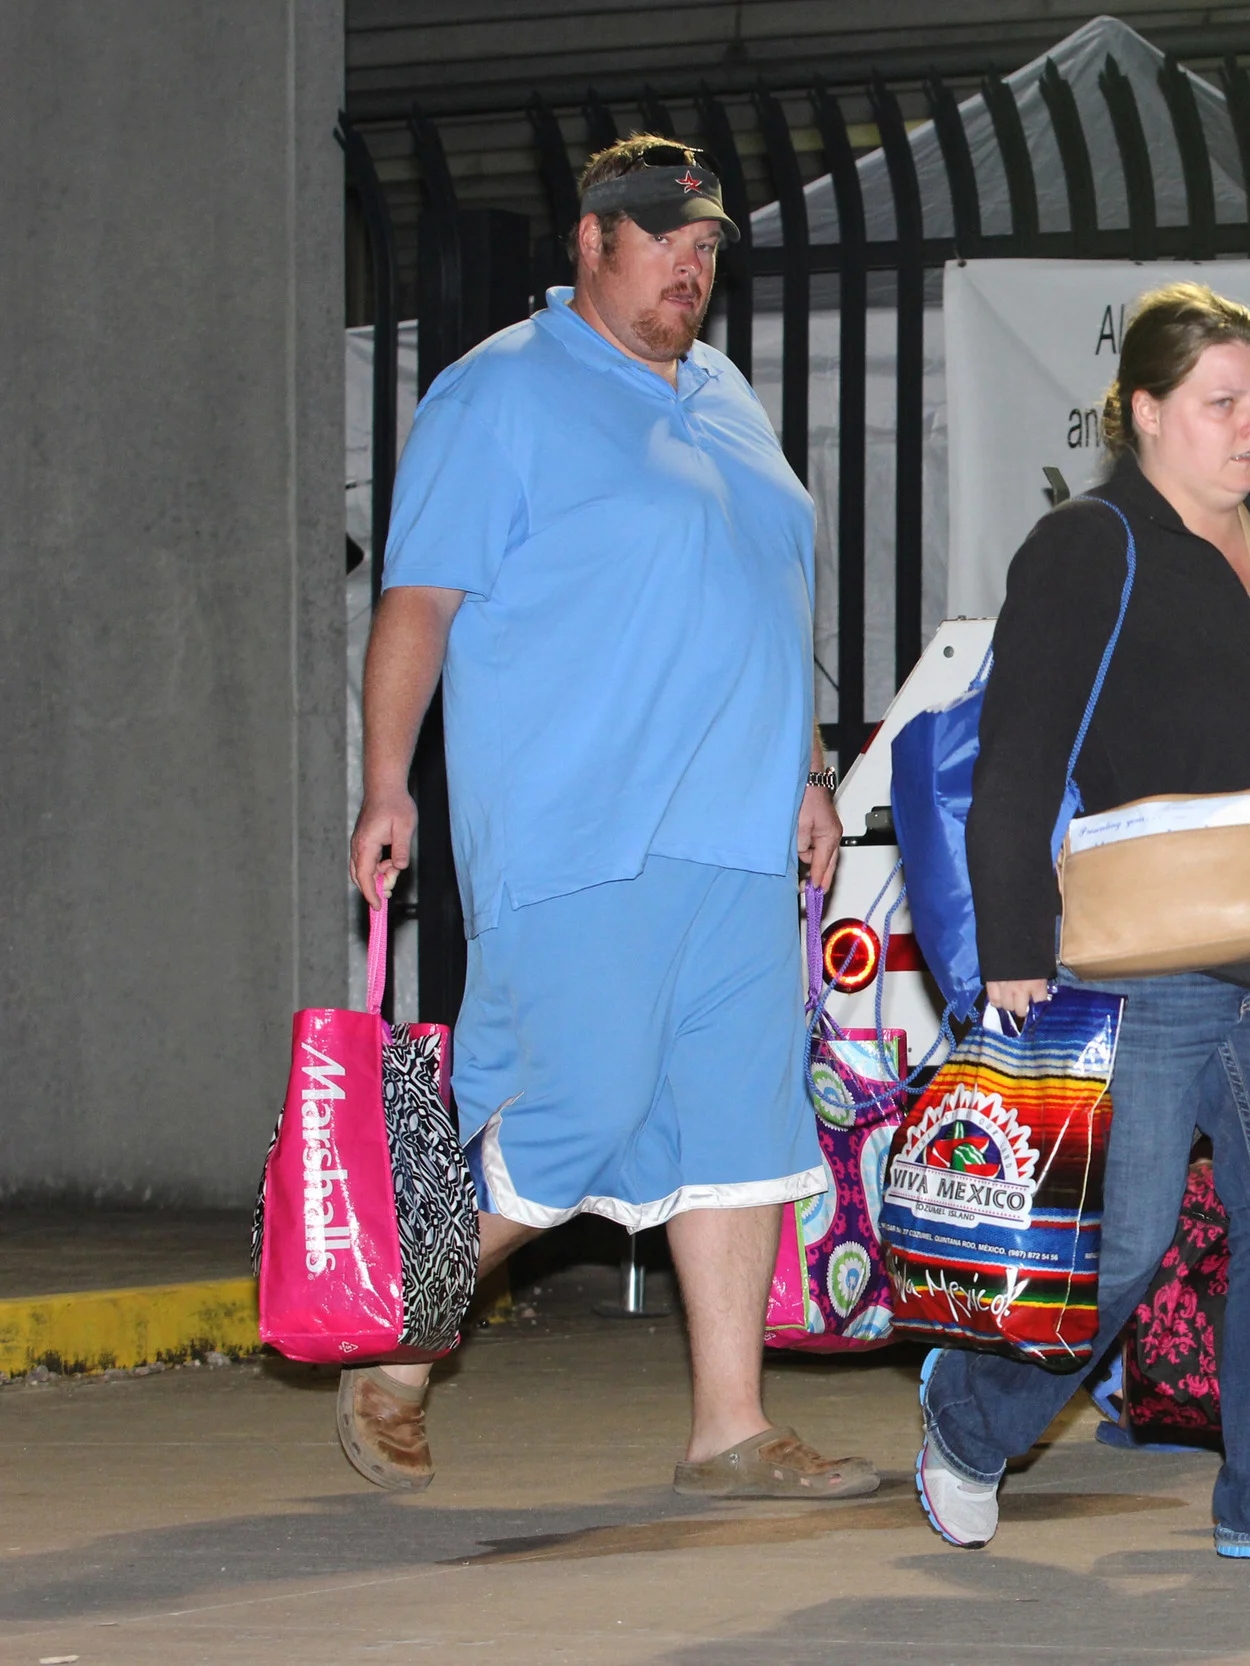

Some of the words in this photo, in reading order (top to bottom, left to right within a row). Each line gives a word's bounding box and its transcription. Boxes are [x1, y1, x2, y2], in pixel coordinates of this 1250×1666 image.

[1095, 303, 1125, 355] Al
[1067, 408, 1099, 449] an
[300, 1042, 350, 1274] Marshalls
[894, 1168, 928, 1194] VIVA
[937, 1178, 1026, 1212] MEXICO
[947, 1210, 976, 1221] ISLAND
